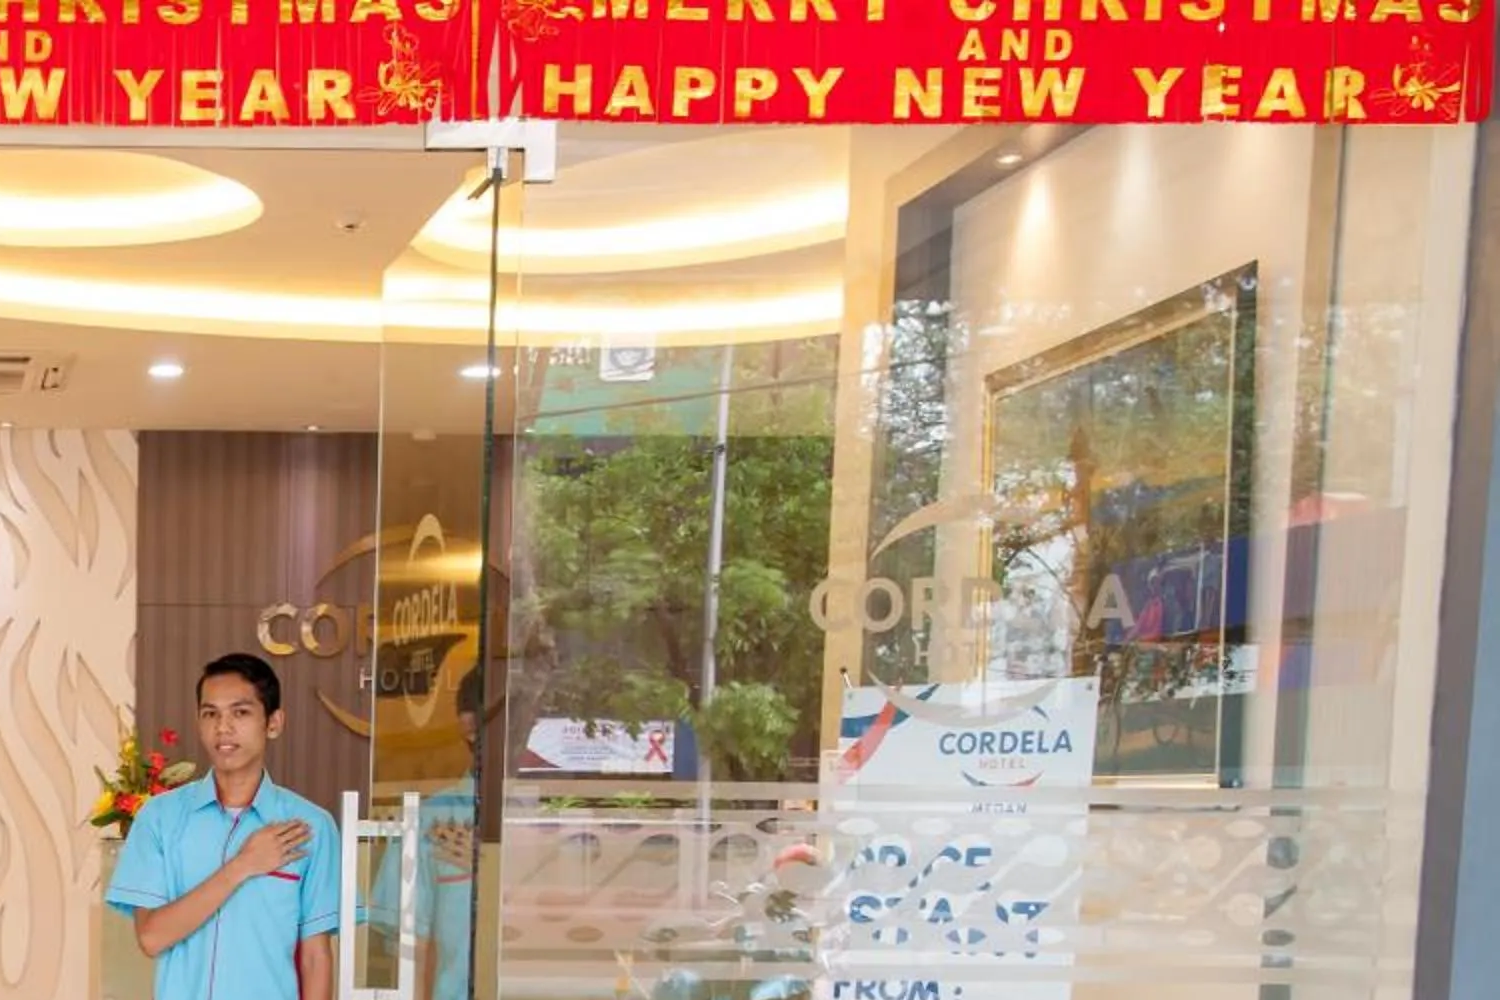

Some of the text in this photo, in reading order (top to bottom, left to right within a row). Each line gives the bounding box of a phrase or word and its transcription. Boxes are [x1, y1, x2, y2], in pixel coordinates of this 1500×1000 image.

[957, 28, 1073, 61] AND
[112, 68, 358, 121] YEAR
[542, 63, 1368, 120] HAPPY NEW YEAR
[939, 729, 1073, 755] CORDELA
